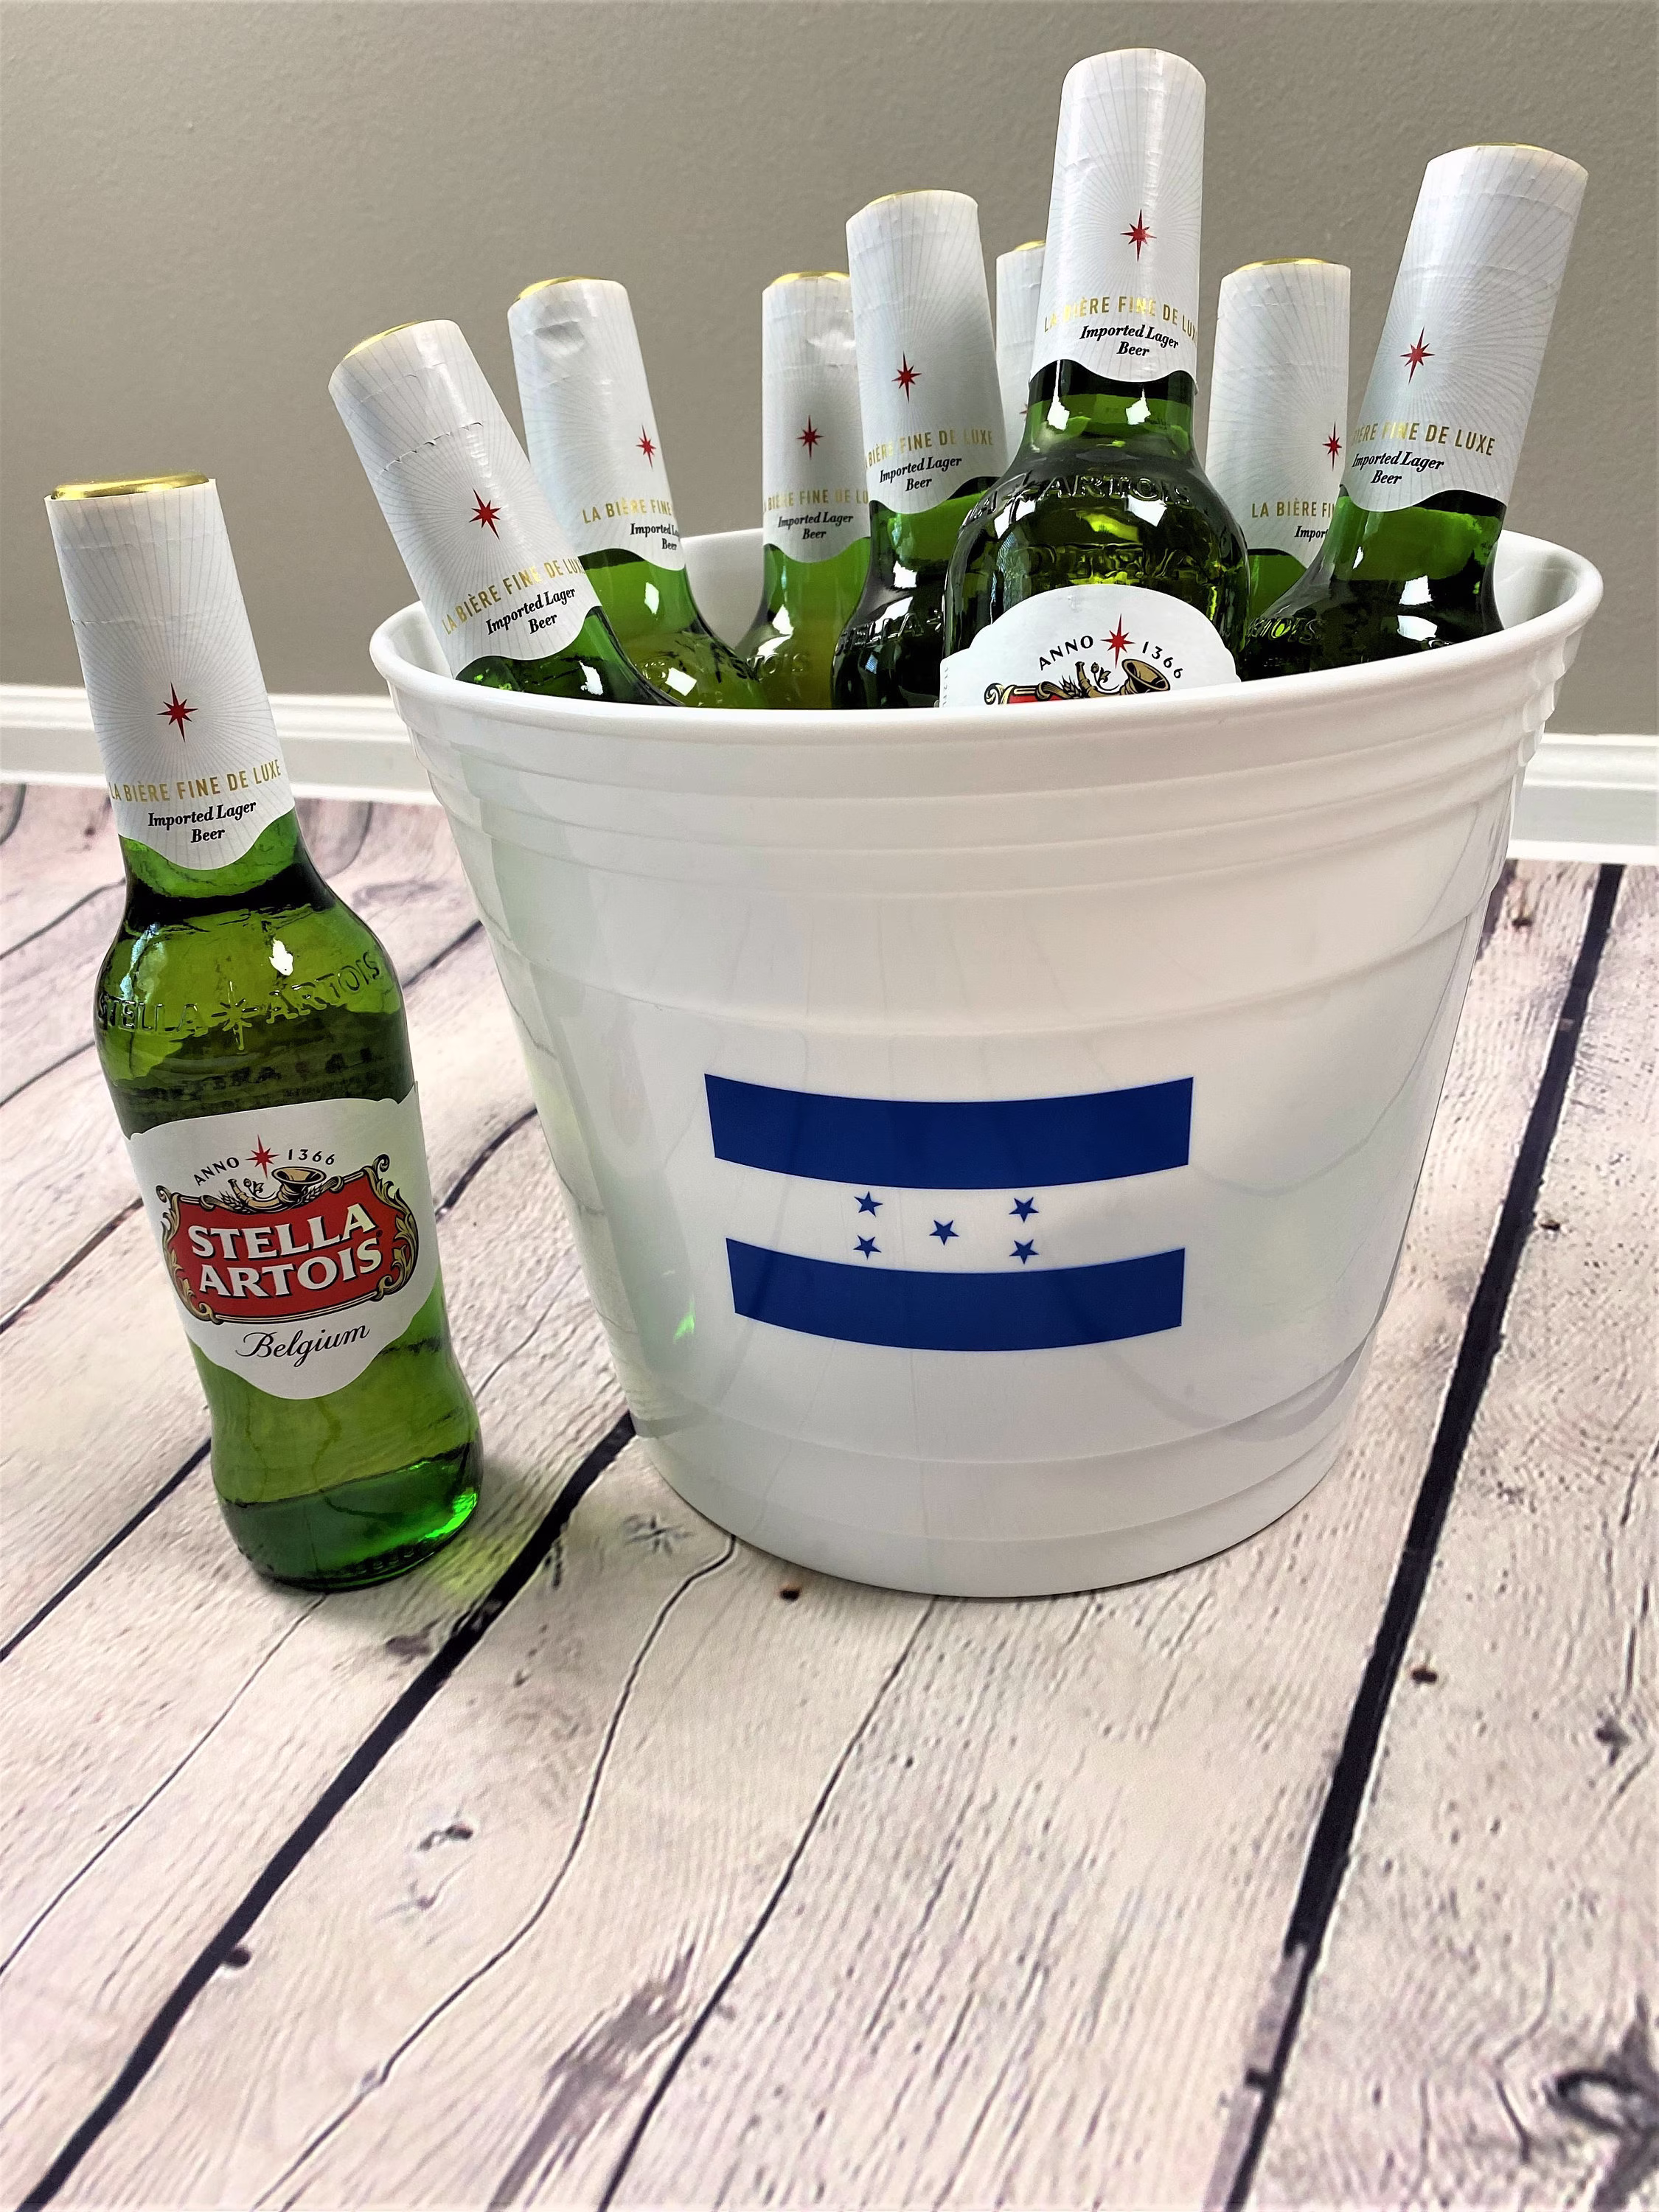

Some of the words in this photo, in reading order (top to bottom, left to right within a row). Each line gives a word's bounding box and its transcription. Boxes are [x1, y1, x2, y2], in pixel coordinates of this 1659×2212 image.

[1044, 313, 1058, 333] LA
[1118, 296, 1157, 316] FINE
[1162, 304, 1178, 326] DE
[1079, 324, 1146, 342] Imported
[1145, 326, 1179, 349] Lager
[1116, 341, 1150, 357] Beer
[900, 431, 933, 453] FINE
[964, 429, 994, 446] LUXE
[1382, 421, 1420, 440] FINE
[1425, 424, 1450, 444] DE
[1454, 429, 1495, 456] LUXE
[879, 458, 925, 484] Imported
[925, 456, 962, 472] Lager
[1352, 451, 1402, 470] Imported
[1400, 451, 1444, 472] Lager
[905, 478, 933, 492] Beer
[1370, 469, 1402, 484] Beer
[799, 489, 829, 505] FINE
[1251, 502, 1269, 518] LA
[1276, 497, 1318, 517] BIÈRE
[582, 506, 602, 524] LA
[777, 512, 821, 530] Imported
[822, 511, 854, 526] Lager
[630, 523, 672, 538] Imported
[802, 528, 827, 540] Beer
[661, 538, 678, 551] Beer
[442, 613, 458, 636] LA
[454, 584, 501, 625] BIÈRE
[502, 566, 542, 597] FINE
[543, 559, 564, 580] DE
[484, 594, 545, 636] Imported
[544, 587, 576, 608] Lager
[527, 613, 558, 635] Beer
[1038, 635, 1095, 671] ANNO
[1142, 641, 1184, 680] 1366
[109, 782, 122, 801] LA
[124, 780, 170, 804] BIÈRE
[176, 776, 221, 800] FINE
[226, 770, 249, 791] DE
[252, 759, 282, 785] LUXE
[147, 806, 215, 831] Imported
[216, 801, 257, 822] Lager
[190, 827, 226, 844] Beer
[265, 950, 380, 1024] ARTOIS
[193, 1156, 240, 1186] ANNO
[288, 1148, 336, 1166] 1366
[187, 1202, 378, 1262] STELLA
[198, 1237, 384, 1300] ARTOIS
[234, 1325, 372, 1368] Belgium
